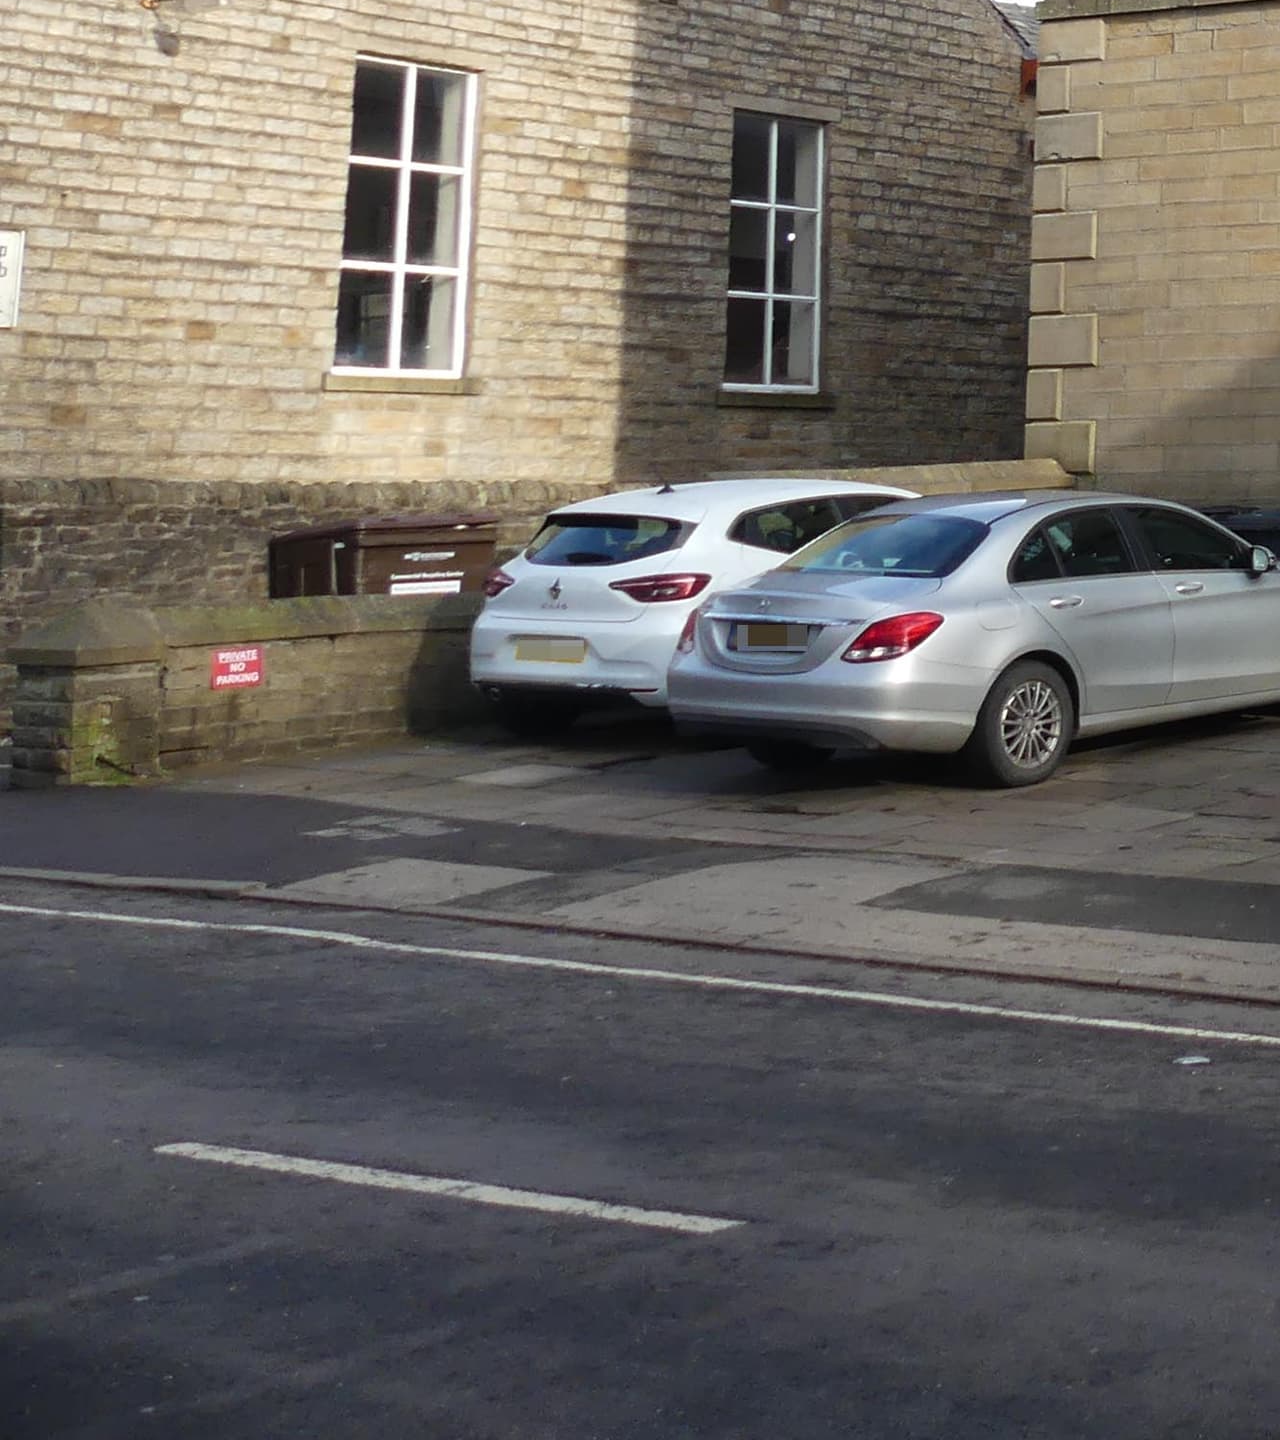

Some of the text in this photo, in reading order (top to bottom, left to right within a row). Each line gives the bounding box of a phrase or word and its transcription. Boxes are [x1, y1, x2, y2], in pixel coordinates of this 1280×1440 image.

[218, 649, 259, 663] PRIVATE
[229, 662, 246, 673] NO
[216, 672, 259, 686] PARKING
